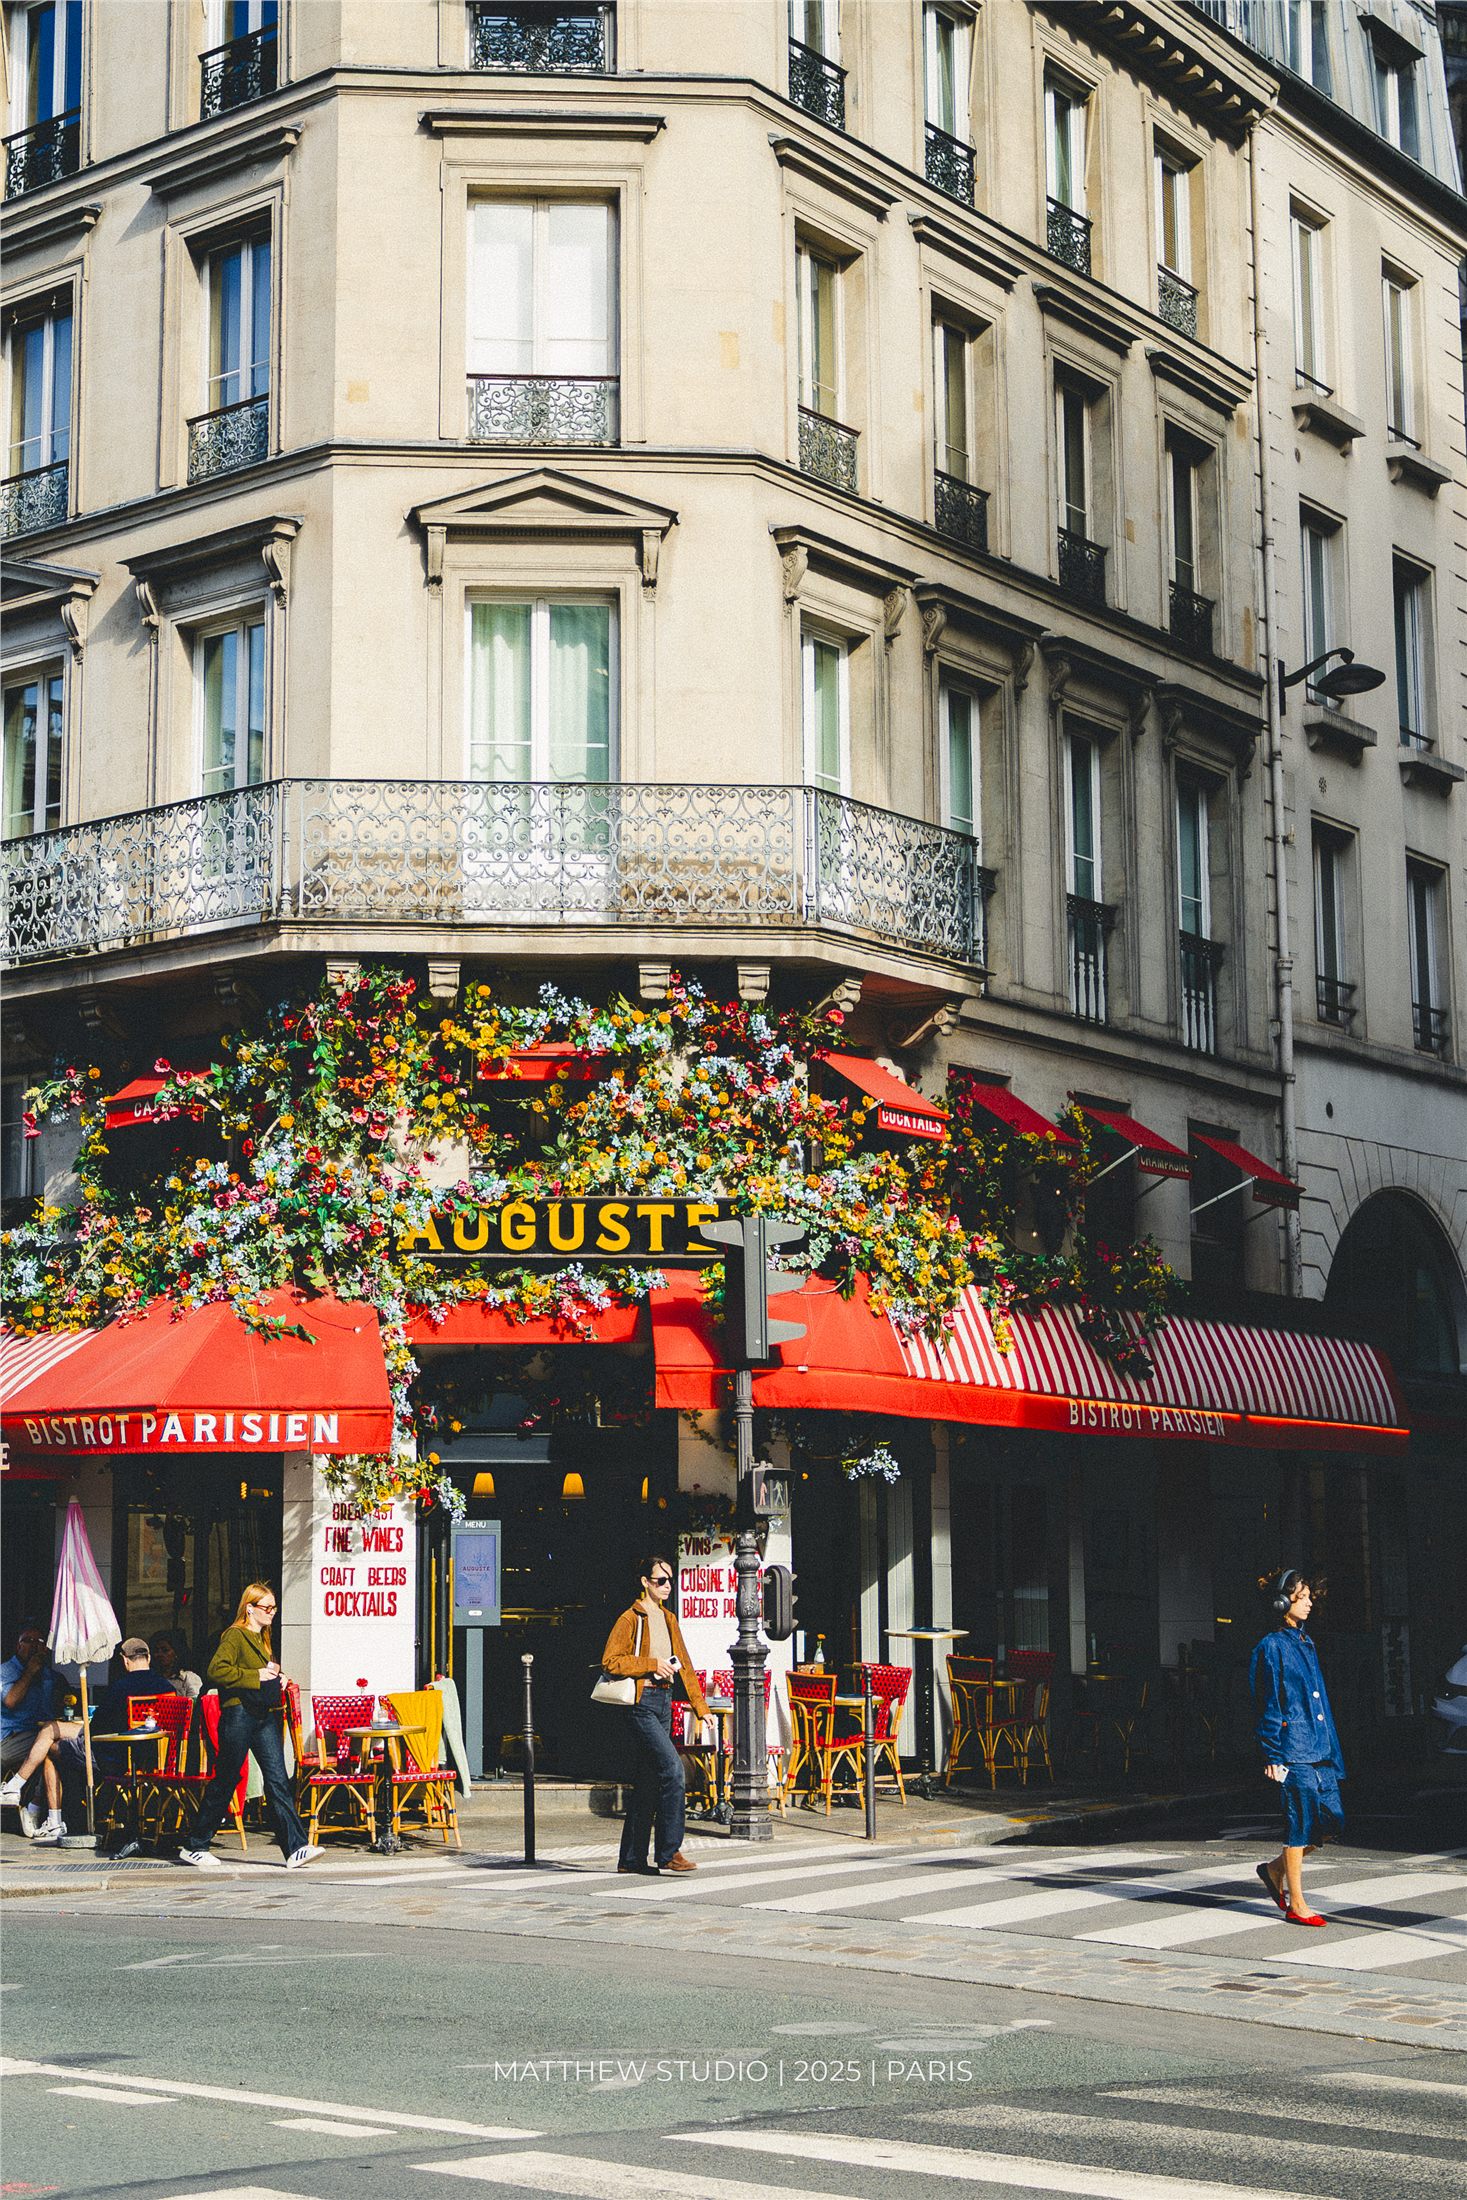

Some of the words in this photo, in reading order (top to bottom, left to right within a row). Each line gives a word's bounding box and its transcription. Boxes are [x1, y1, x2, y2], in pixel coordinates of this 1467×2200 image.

[881, 1108, 942, 1134] COCKTAILS
[23, 1414, 130, 1445] BISTROT
[141, 1411, 340, 1444] PARISIEN
[1069, 1399, 1142, 1430] BISTROT
[1150, 1407, 1226, 1437] PARISIEN
[465, 1521, 487, 1529] MENU
[320, 1566, 356, 1587] CRAFT
[367, 1566, 407, 1587] BEERS
[324, 1591, 398, 1617] COCKTAILS
[682, 1596, 719, 1619] BIÈRES
